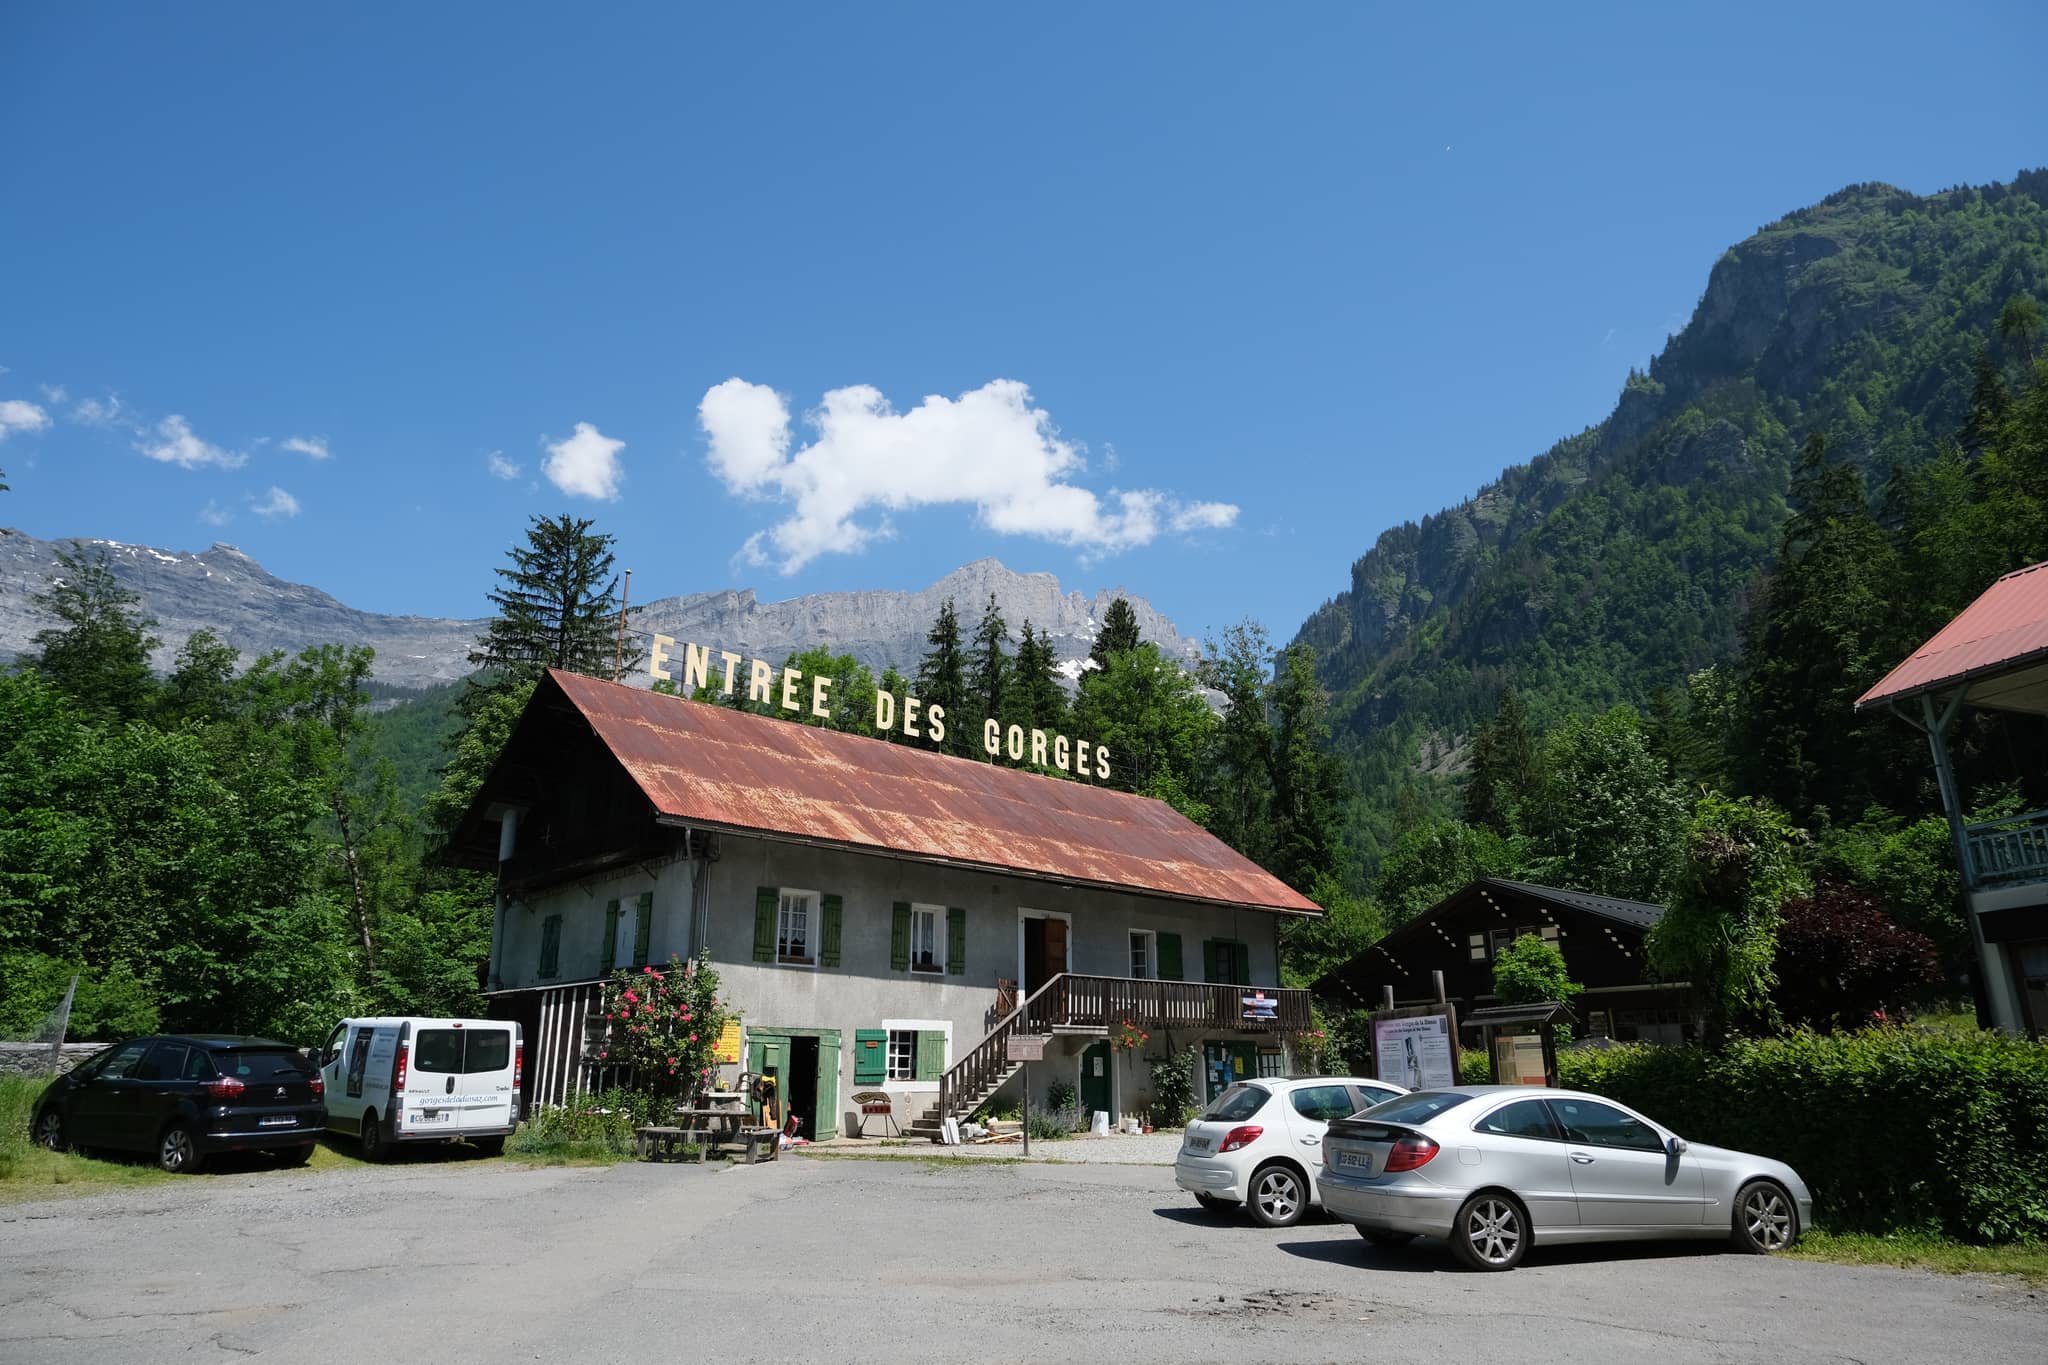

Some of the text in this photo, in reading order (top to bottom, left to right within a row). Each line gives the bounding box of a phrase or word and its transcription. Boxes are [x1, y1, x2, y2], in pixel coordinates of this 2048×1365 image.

[649, 633, 1111, 780] ENTREE DES GORGES
